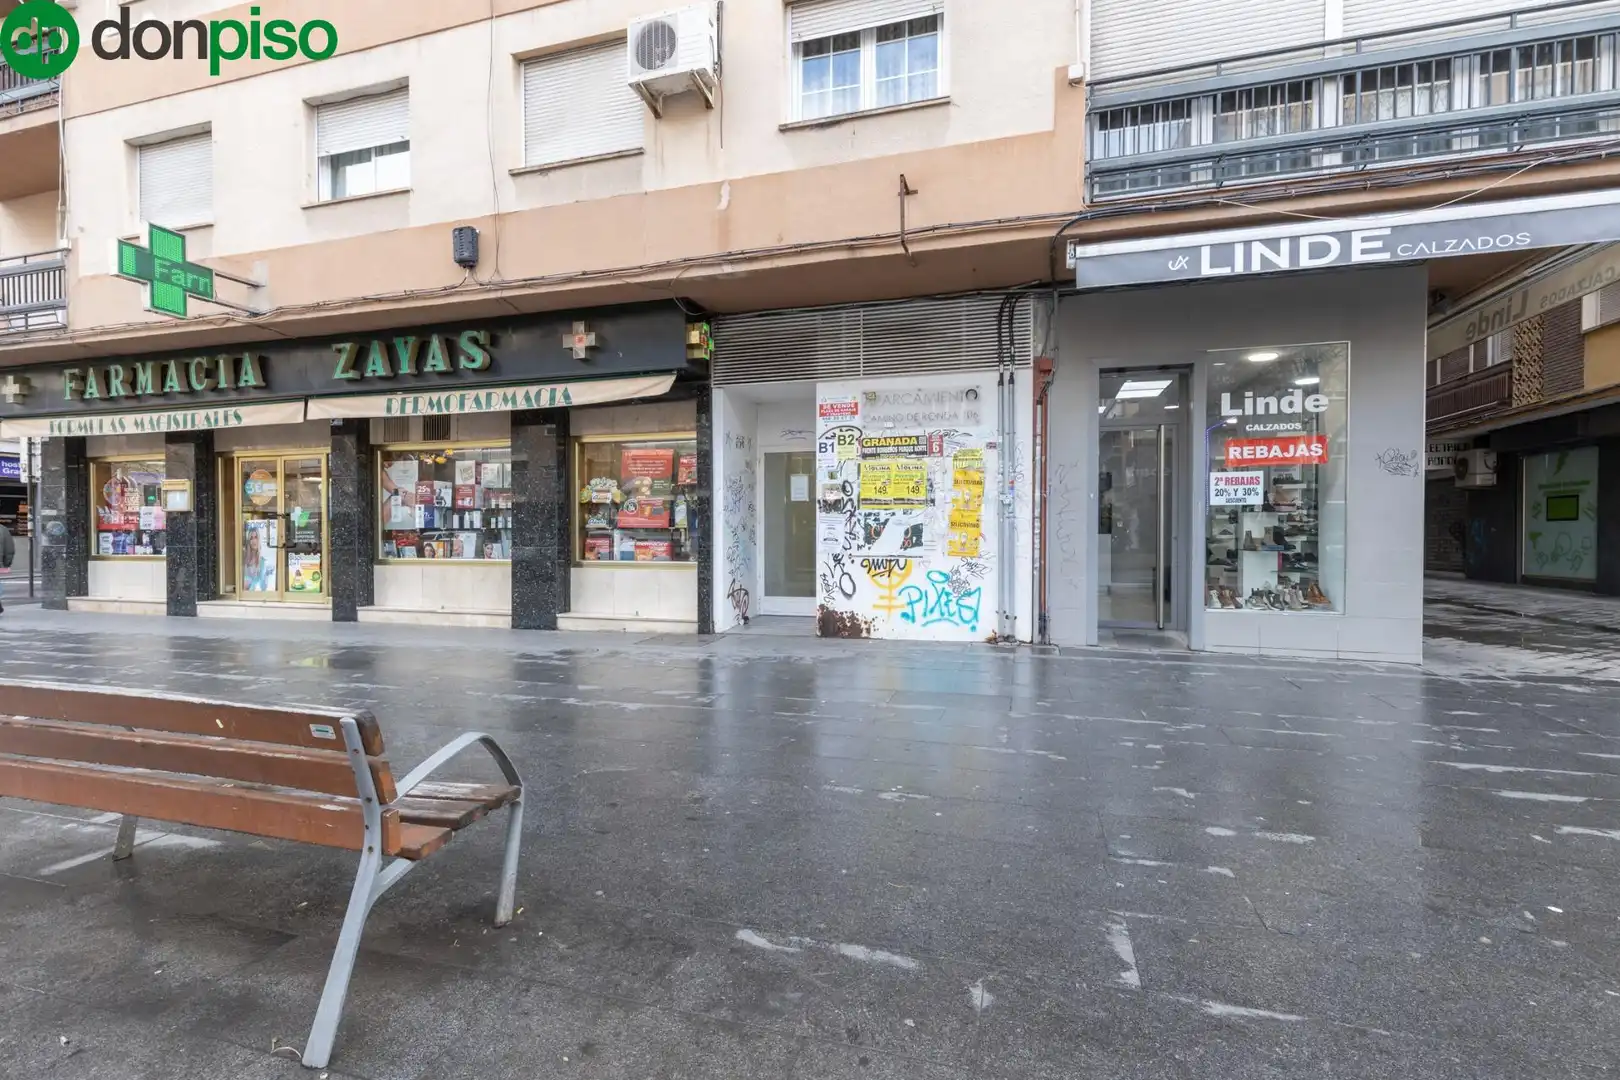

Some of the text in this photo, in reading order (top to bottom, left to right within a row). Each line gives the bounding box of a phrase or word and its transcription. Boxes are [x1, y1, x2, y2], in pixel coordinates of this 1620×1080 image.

[1200, 227, 1532, 276] LINDE CALZADOS
[331, 330, 490, 380] ZAYAS
[63, 352, 262, 401] FARMACIA
[385, 384, 573, 417] DERMOFARMACIA
[1221, 388, 1329, 416] Linde
[133, 408, 243, 433] MAGISTRALES
[1245, 422, 1302, 431] CALZADOS
[818, 441, 835, 454] B1
[837, 434, 855, 446] B2
[862, 436, 918, 448] GRANADA
[932, 441, 940, 453] 6
[1228, 443, 1323, 460] REBAJAS
[1224, 475, 1261, 486] REBAJAS
[1214, 486, 1260, 498] 20% Y 30%
